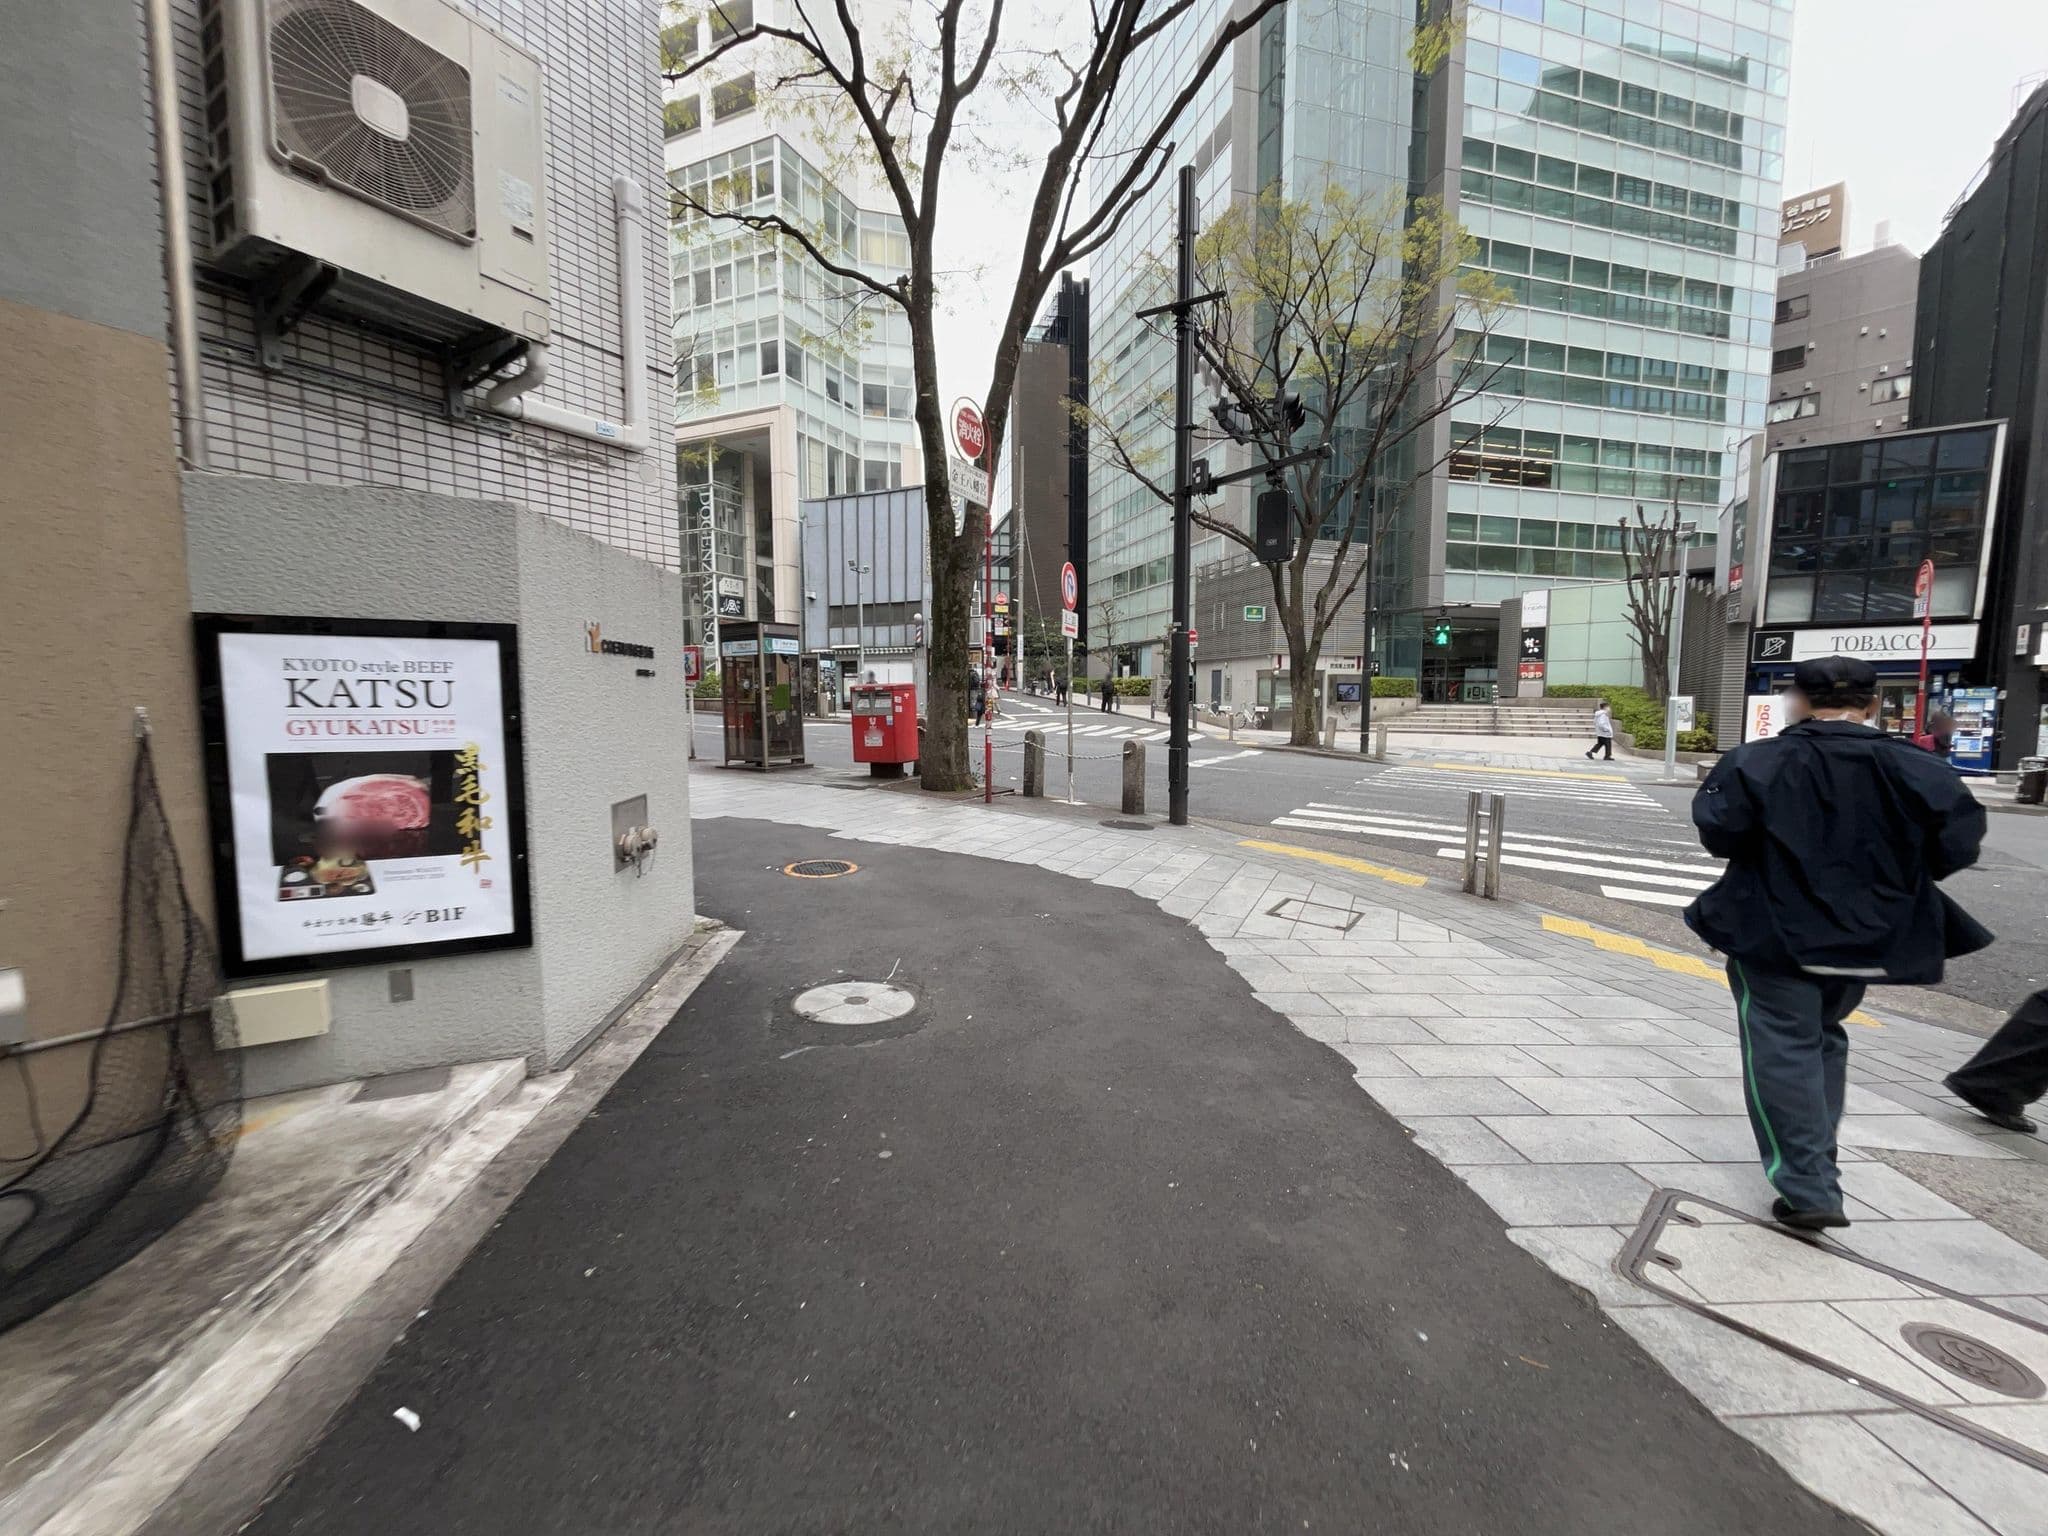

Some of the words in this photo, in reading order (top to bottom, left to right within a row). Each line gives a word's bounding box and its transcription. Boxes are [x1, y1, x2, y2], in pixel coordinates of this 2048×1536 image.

[958, 418, 982, 447] 消火栓
[1831, 633, 1937, 651] TOBACCO
[282, 658, 358, 672] KYOTO
[360, 660, 400, 675] style
[402, 660, 454, 674] BEEF
[283, 677, 456, 709] KATSU
[285, 719, 430, 736] GYUKATSU
[1758, 704, 1771, 736] DyDo
[454, 741, 493, 875] 黒毛和牛
[425, 905, 467, 924] B1F
